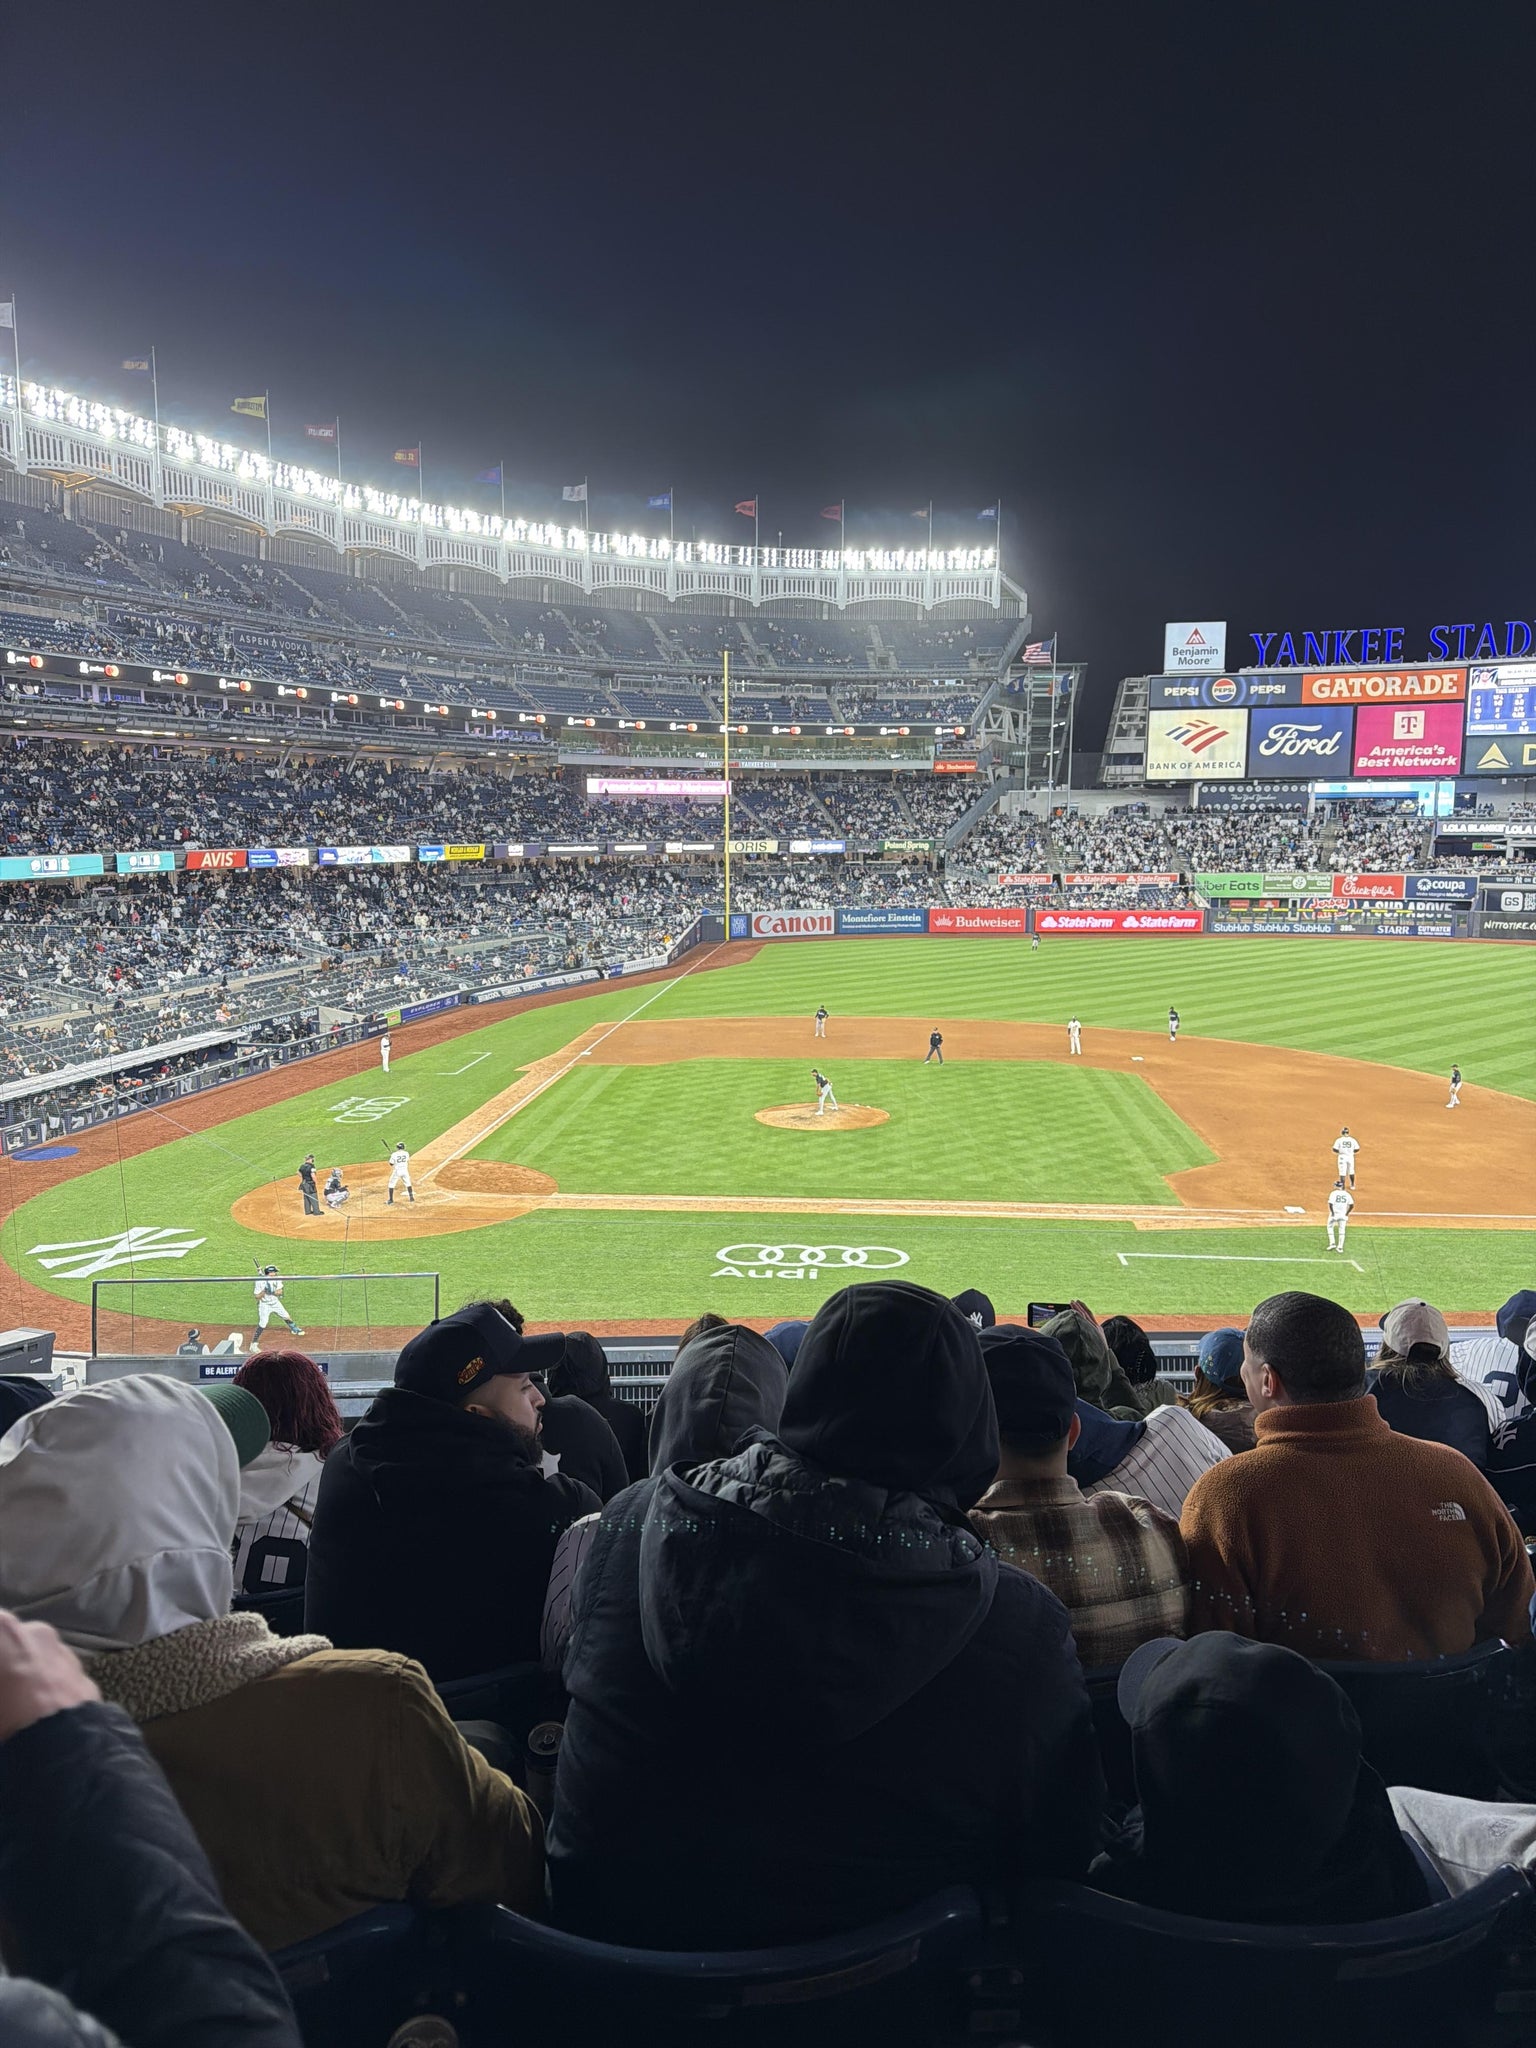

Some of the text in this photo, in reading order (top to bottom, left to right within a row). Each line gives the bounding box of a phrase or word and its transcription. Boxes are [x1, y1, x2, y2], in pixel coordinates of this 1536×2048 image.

[240, 635, 308, 652] ASPEN VODKA
[1250, 620, 1536, 667] YANKEE STAD
[1172, 646, 1219, 657] Benjamin
[1178, 657, 1212, 665] Moore
[1250, 685, 1286, 694] PEPSI
[1312, 674, 1458, 698] GATORADE
[1164, 687, 1200, 696] PEPSI
[1259, 723, 1343, 756] Ford
[1369, 745, 1446, 757] America's
[1149, 762, 1177, 770] BANK
[1195, 761, 1242, 769] AMERICA
[1357, 756, 1458, 768] Best Network
[735, 842, 767, 852] ORIS
[884, 841, 930, 851] Poland Spring
[201, 852, 233, 867] AVIS
[1229, 881, 1259, 891] Eats
[1433, 880, 1466, 892] coupa
[1310, 898, 1349, 909] Jersey
[1505, 897, 1519, 906] GS
[842, 913, 921, 923] Montefiore Einstein
[955, 916, 1020, 927] Budweiser
[754, 914, 832, 933] Canon
[1214, 924, 1250, 932] StubHub
[1252, 924, 1290, 932] StubHub
[1293, 924, 1331, 932] StubHub
[1377, 926, 1409, 934] STARR
[397, 1155, 407, 1163] 22
[1335, 1195, 1347, 1203] 85
[710, 1266, 818, 1279] Audi
[205, 1367, 214, 1375] BE
[216, 1367, 236, 1375] ALERT
